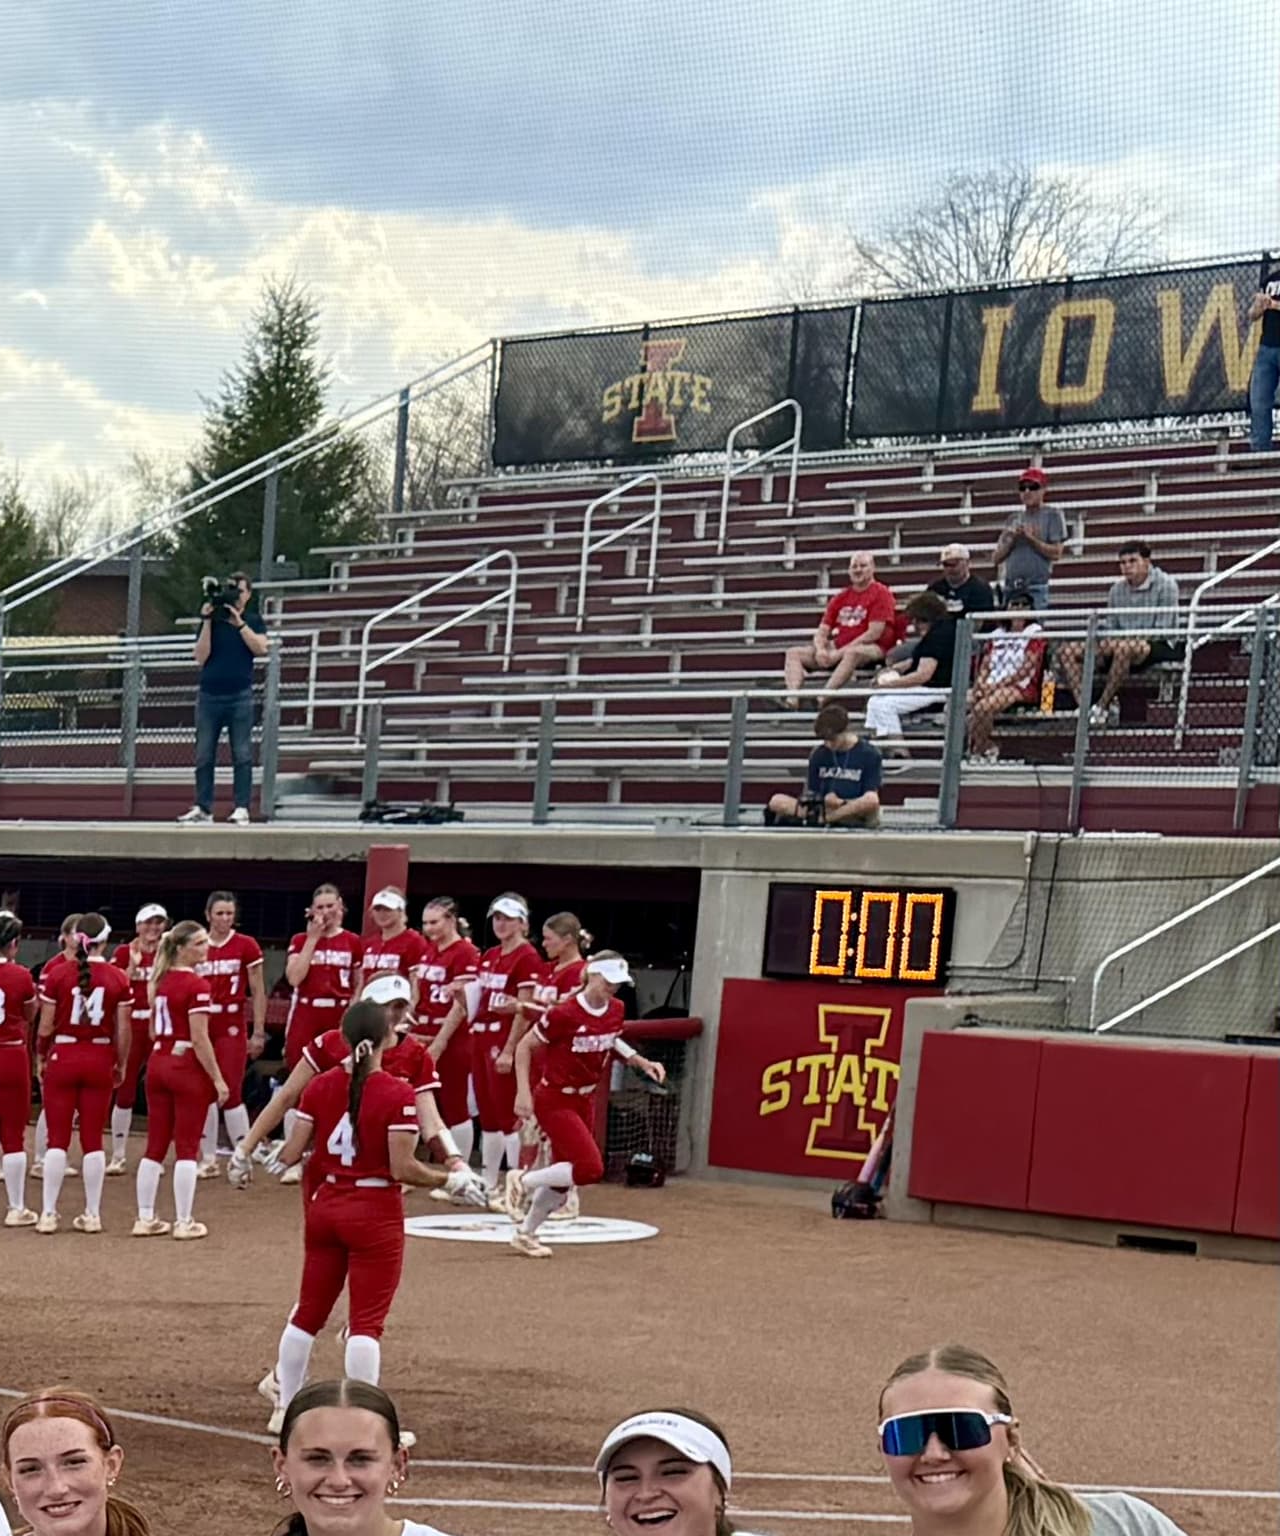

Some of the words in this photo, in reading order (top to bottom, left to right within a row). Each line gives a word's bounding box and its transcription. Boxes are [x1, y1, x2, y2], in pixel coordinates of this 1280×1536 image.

[602, 371, 713, 421] STATE
[810, 890, 943, 981] 0:00
[70, 986, 106, 1026] 14
[759, 1052, 901, 1116] STAT
[326, 1111, 358, 1167] 4
